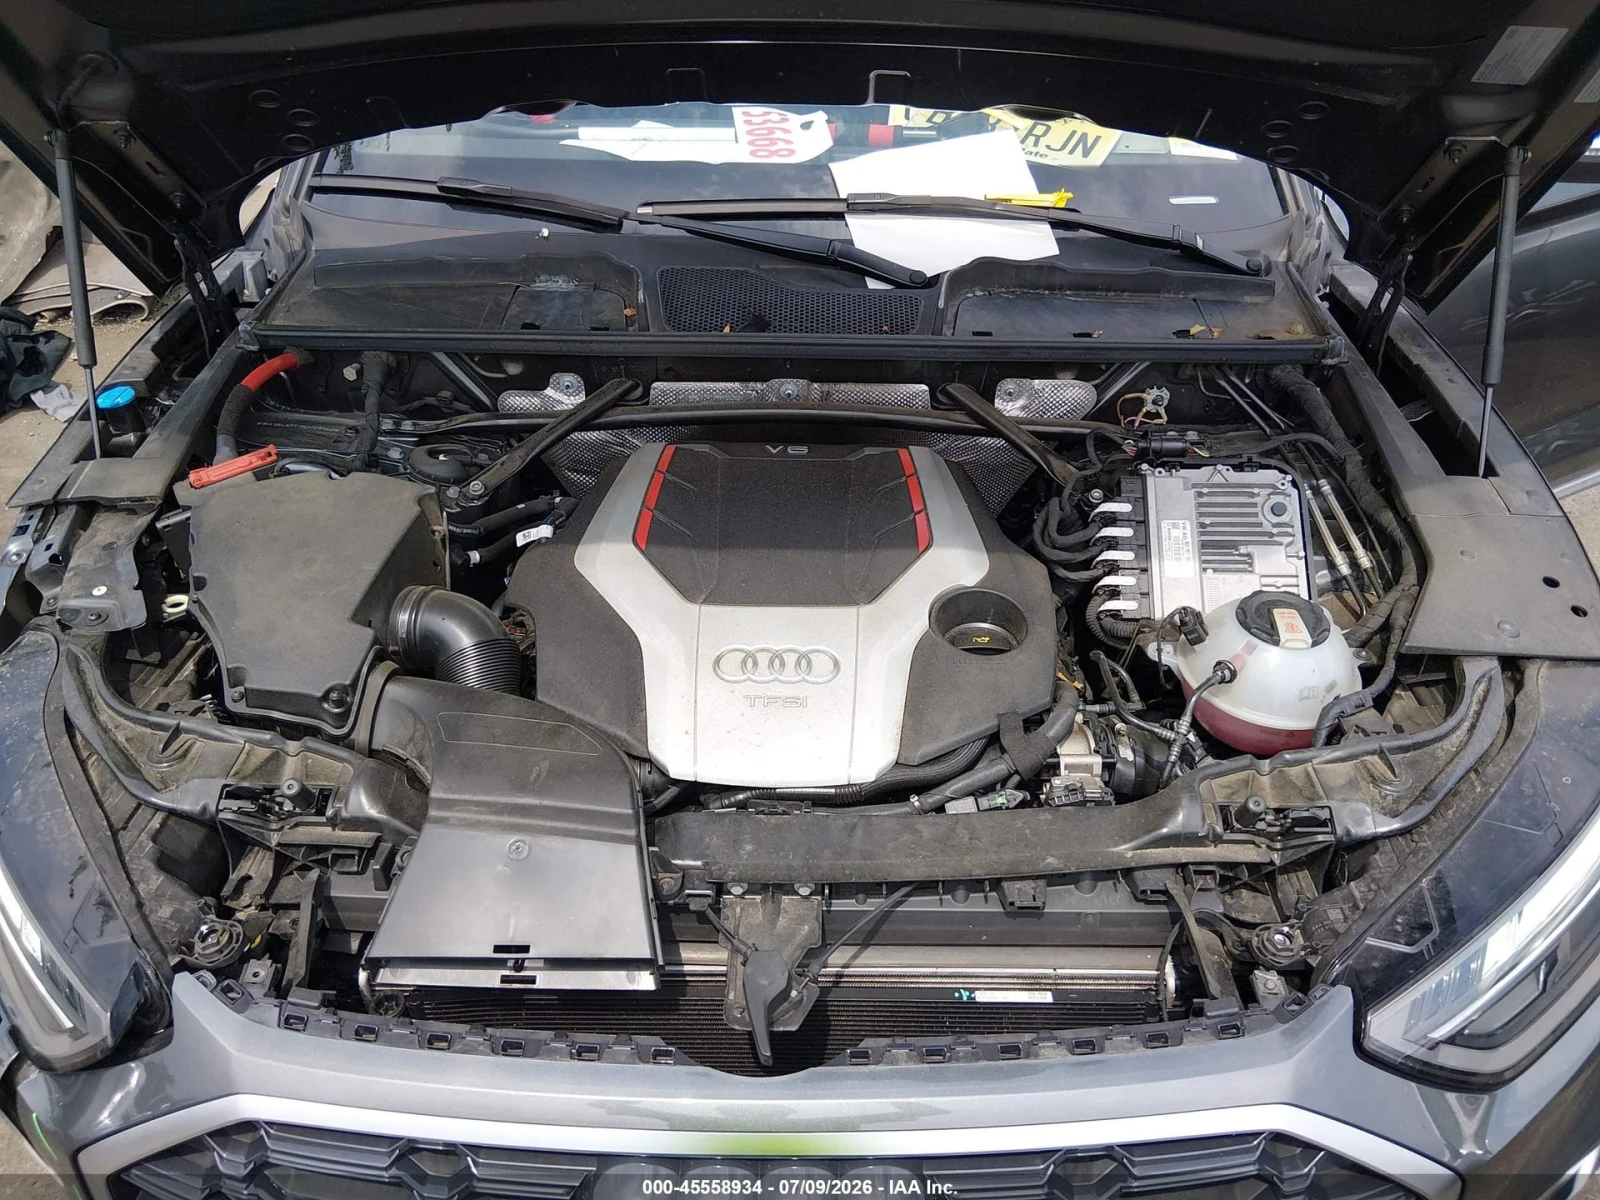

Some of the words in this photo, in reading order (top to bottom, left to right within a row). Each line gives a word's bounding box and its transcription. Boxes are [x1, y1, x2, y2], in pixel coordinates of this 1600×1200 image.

[741, 111, 796, 158] 53668
[1020, 121, 1102, 158] RJN
[765, 444, 809, 455] V6
[743, 695, 807, 708] TFSI
